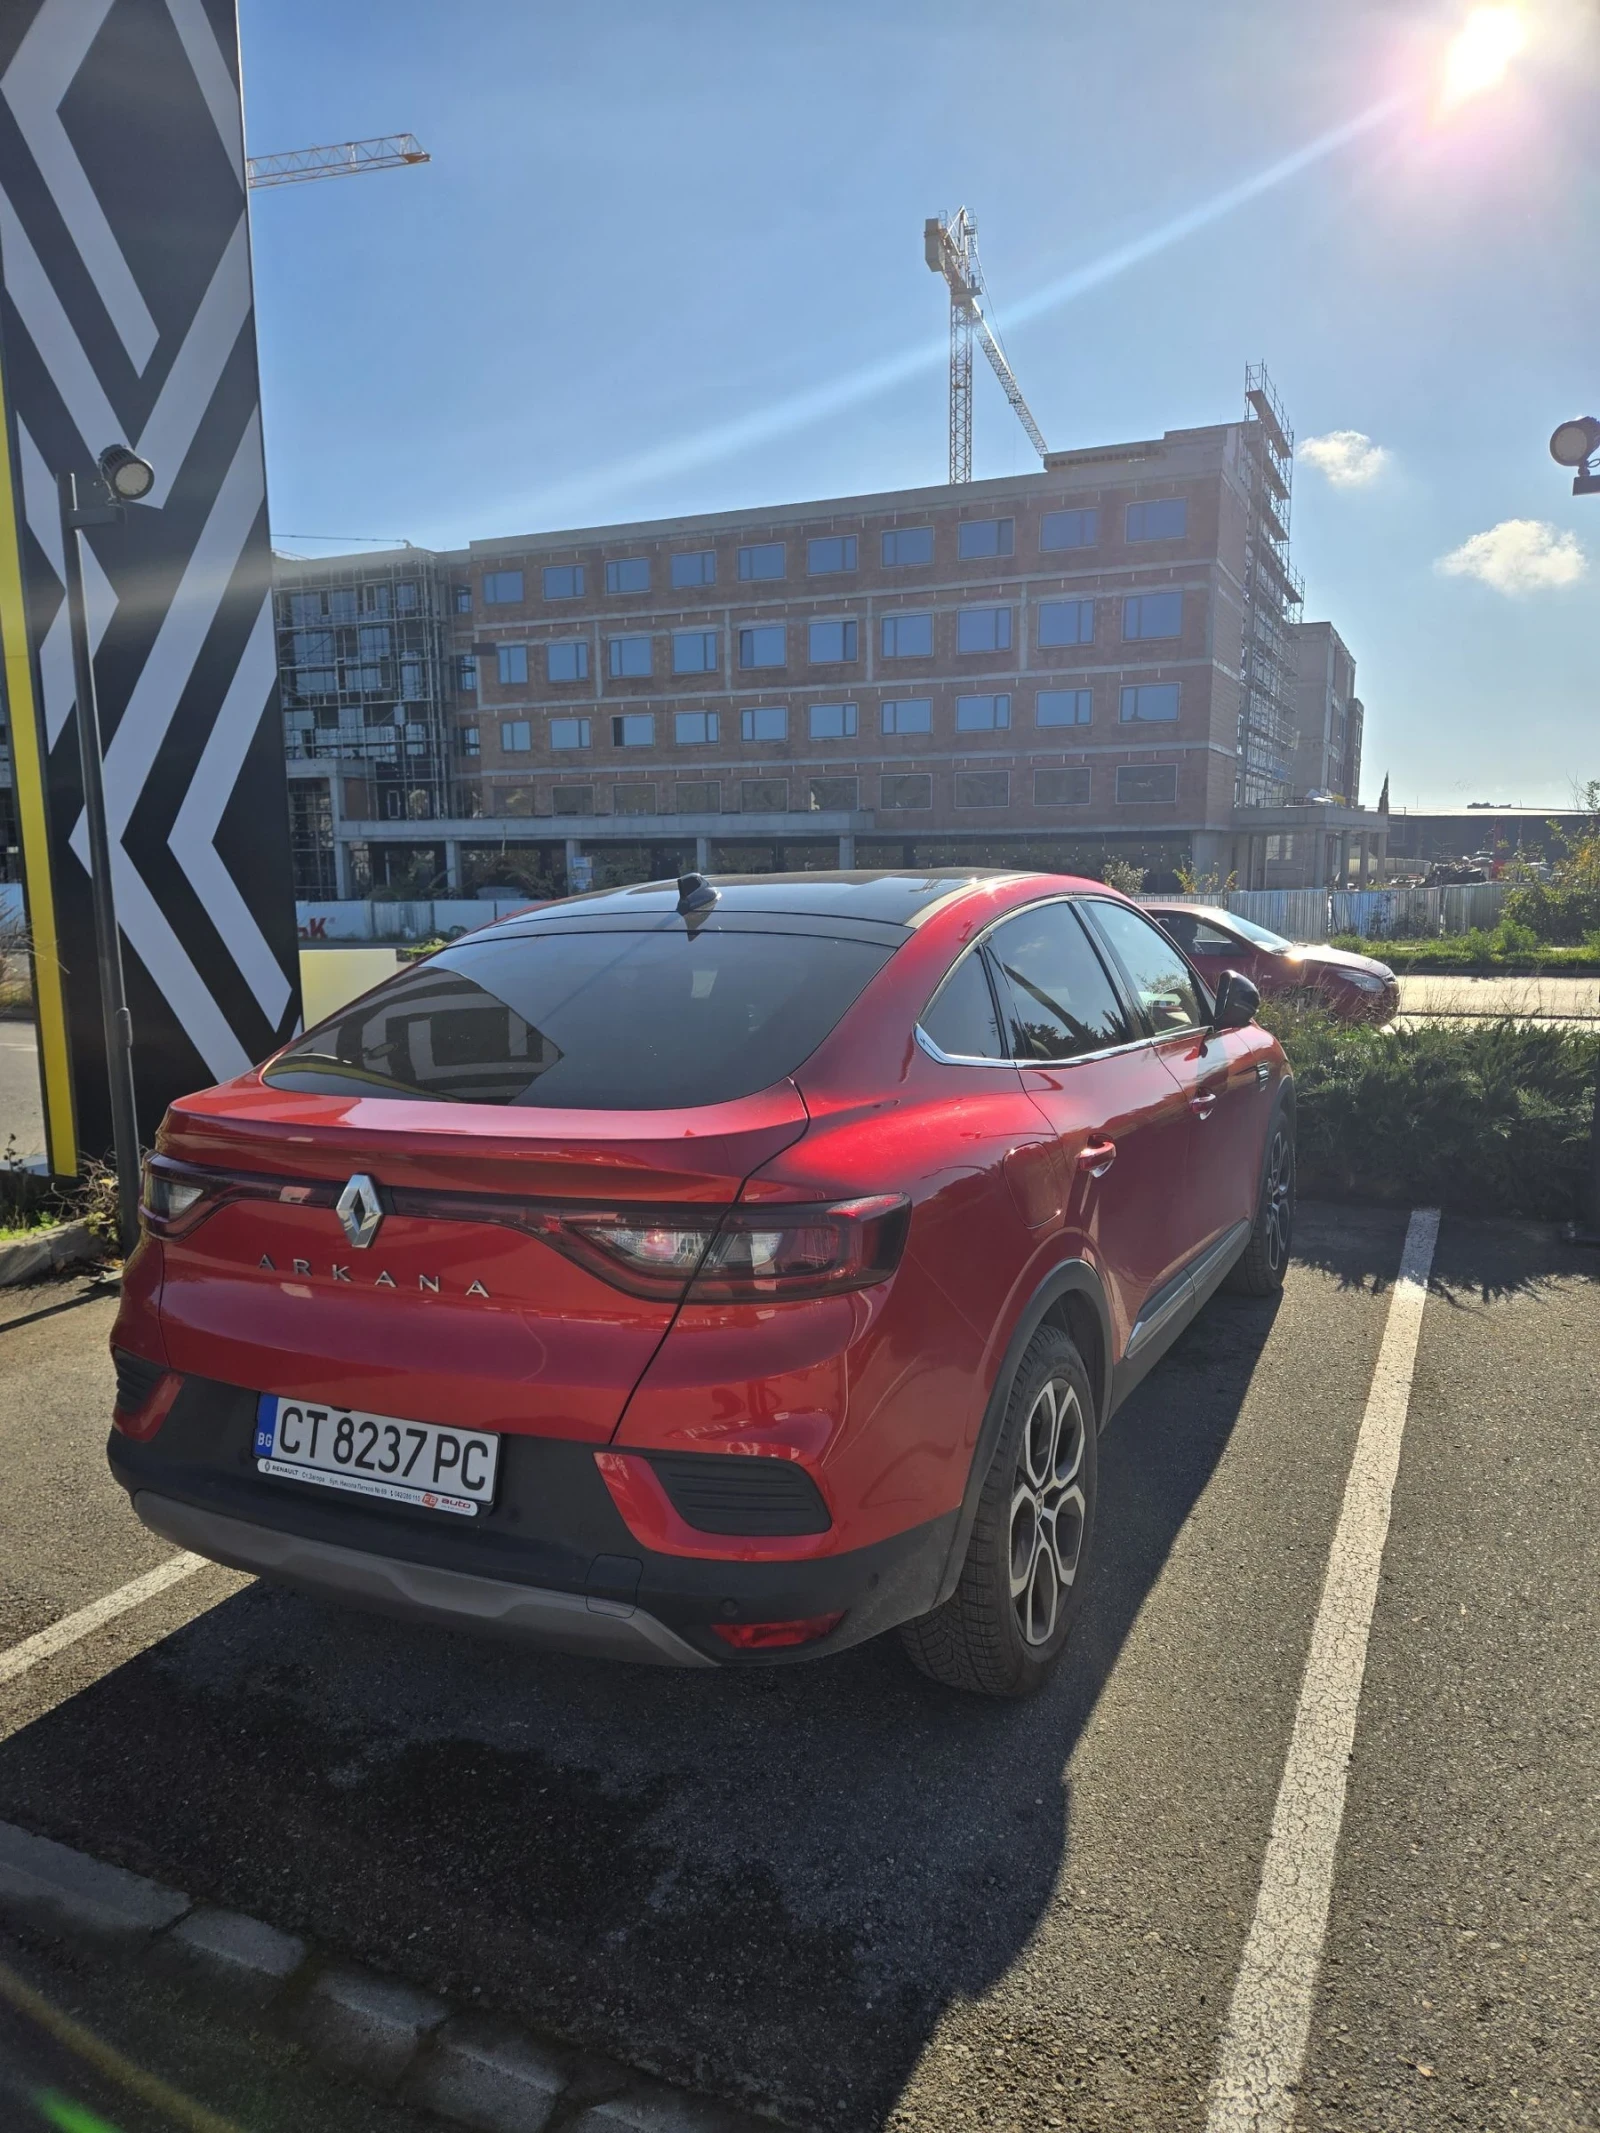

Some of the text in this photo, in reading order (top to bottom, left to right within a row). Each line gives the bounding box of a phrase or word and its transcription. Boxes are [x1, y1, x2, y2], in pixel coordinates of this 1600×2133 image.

[258, 1254, 490, 1298] ARKANA
[257, 1431, 273, 1448] BG
[279, 1406, 489, 1491] CT 8237 PC
[272, 1465, 299, 1476] RENAULT
[423, 1495, 437, 1506] FB
[441, 1497, 471, 1509] auto
